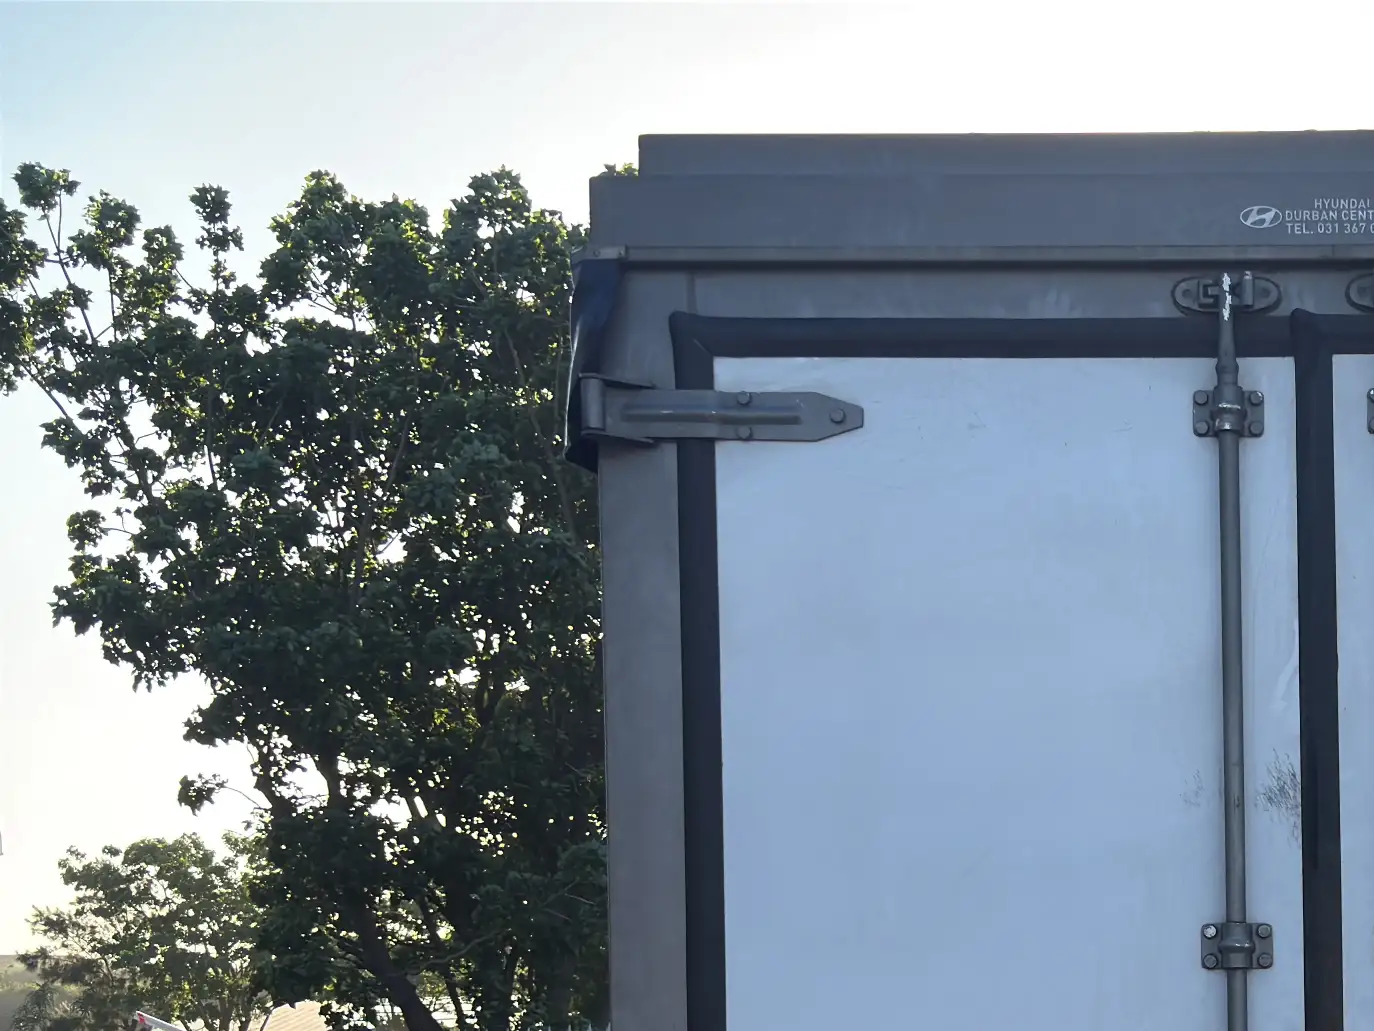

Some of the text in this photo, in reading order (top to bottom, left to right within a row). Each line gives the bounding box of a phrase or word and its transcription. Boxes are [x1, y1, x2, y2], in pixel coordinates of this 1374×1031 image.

[1314, 198, 1370, 209] HYUNDAI
[1285, 210, 1338, 221] DURBAN
[1285, 223, 1314, 234] TEL.
[1317, 223, 1339, 234] 031
[1344, 223, 1366, 234] 367
